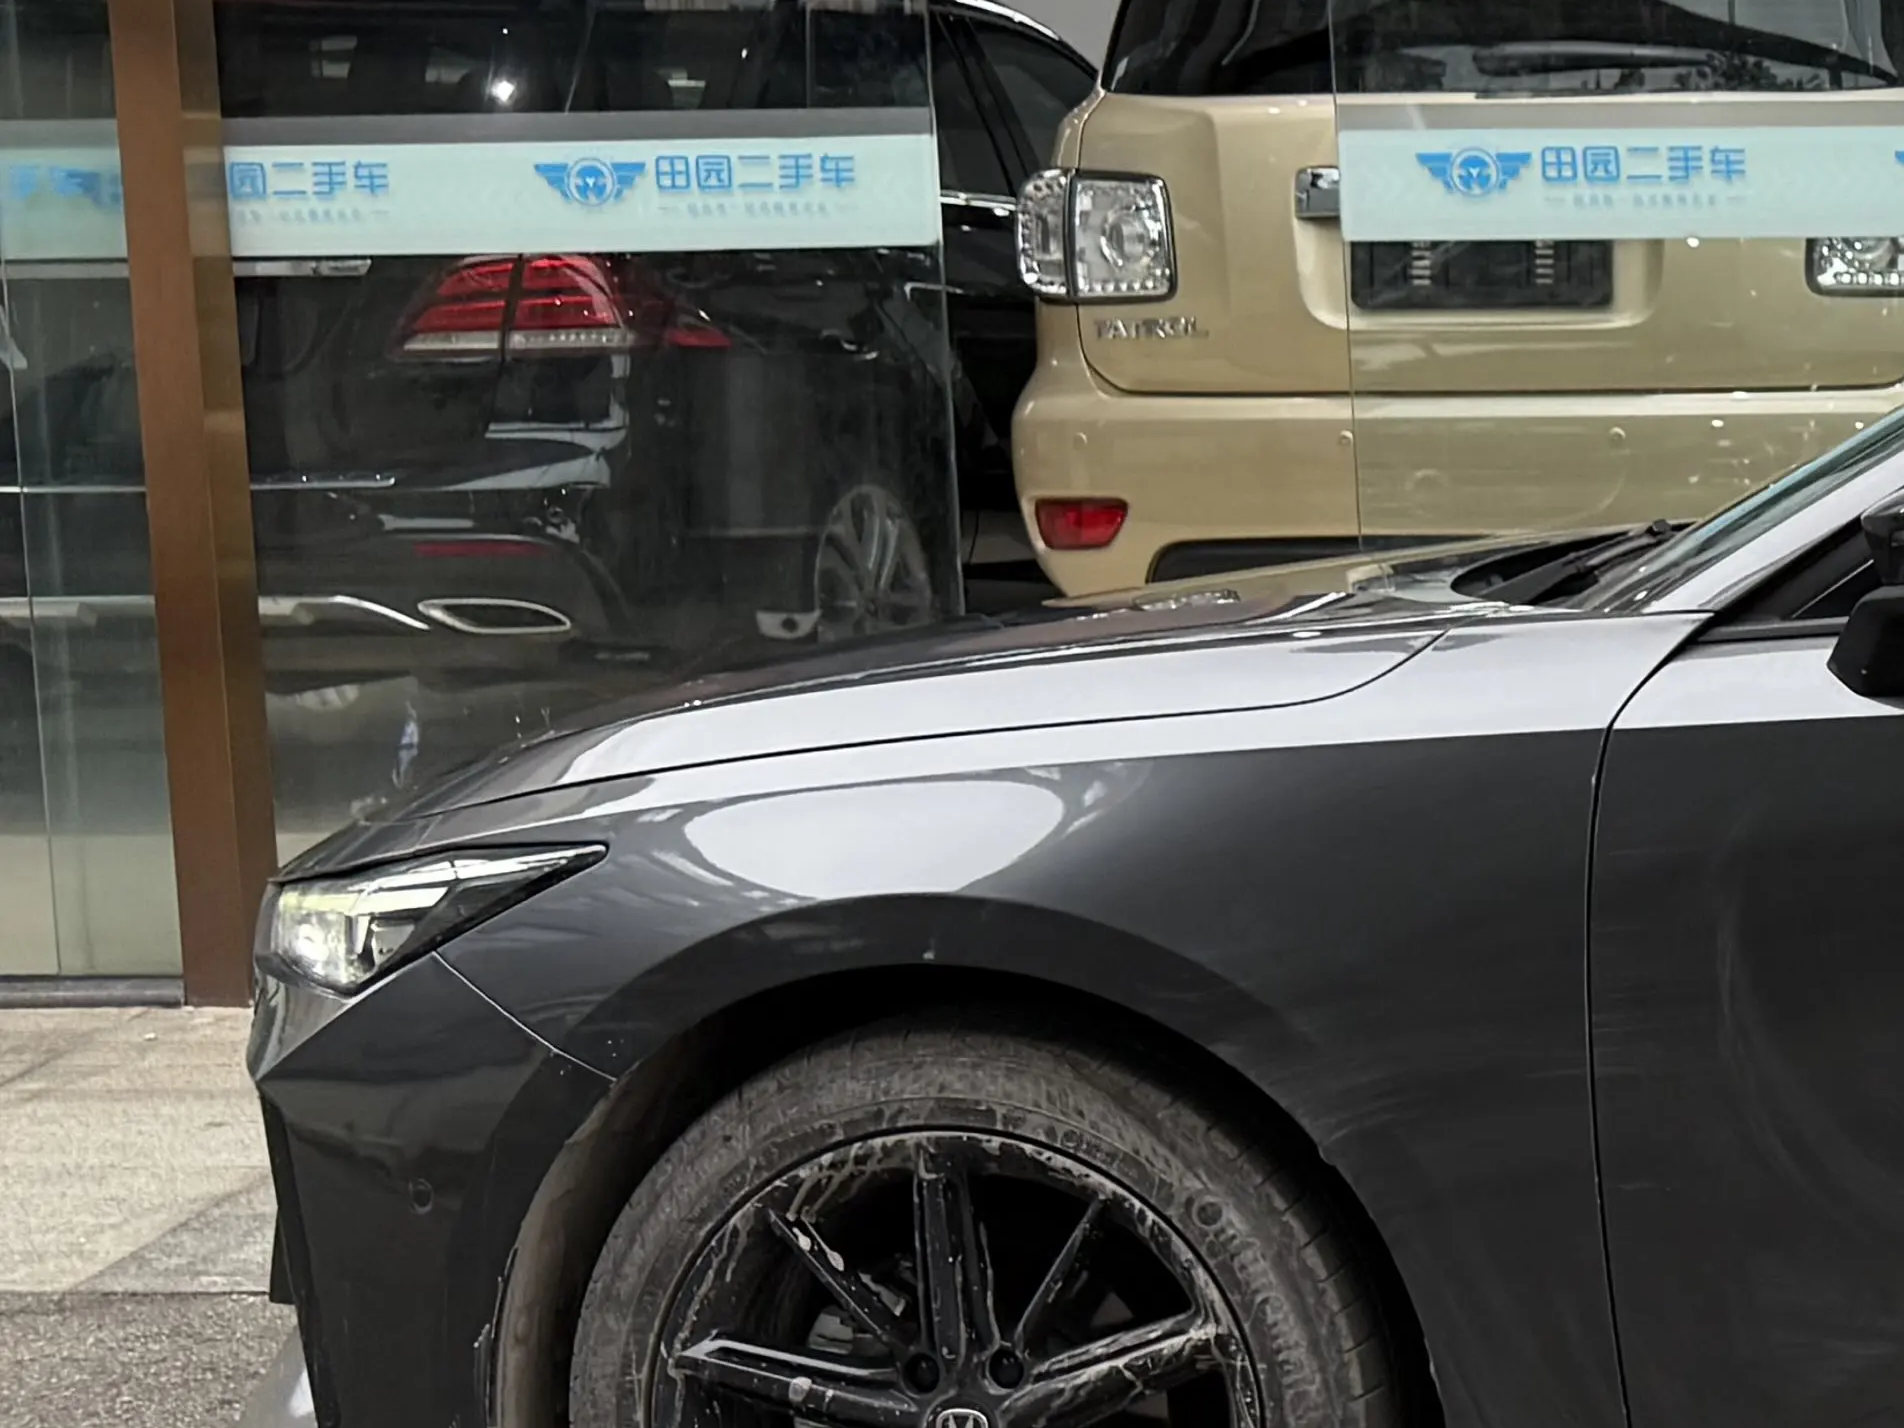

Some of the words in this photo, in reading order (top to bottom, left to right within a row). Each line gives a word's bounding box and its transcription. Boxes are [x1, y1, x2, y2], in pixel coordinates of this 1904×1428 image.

[656, 153, 856, 190] 田园二手车
[1541, 146, 1746, 182] 田园二手车
